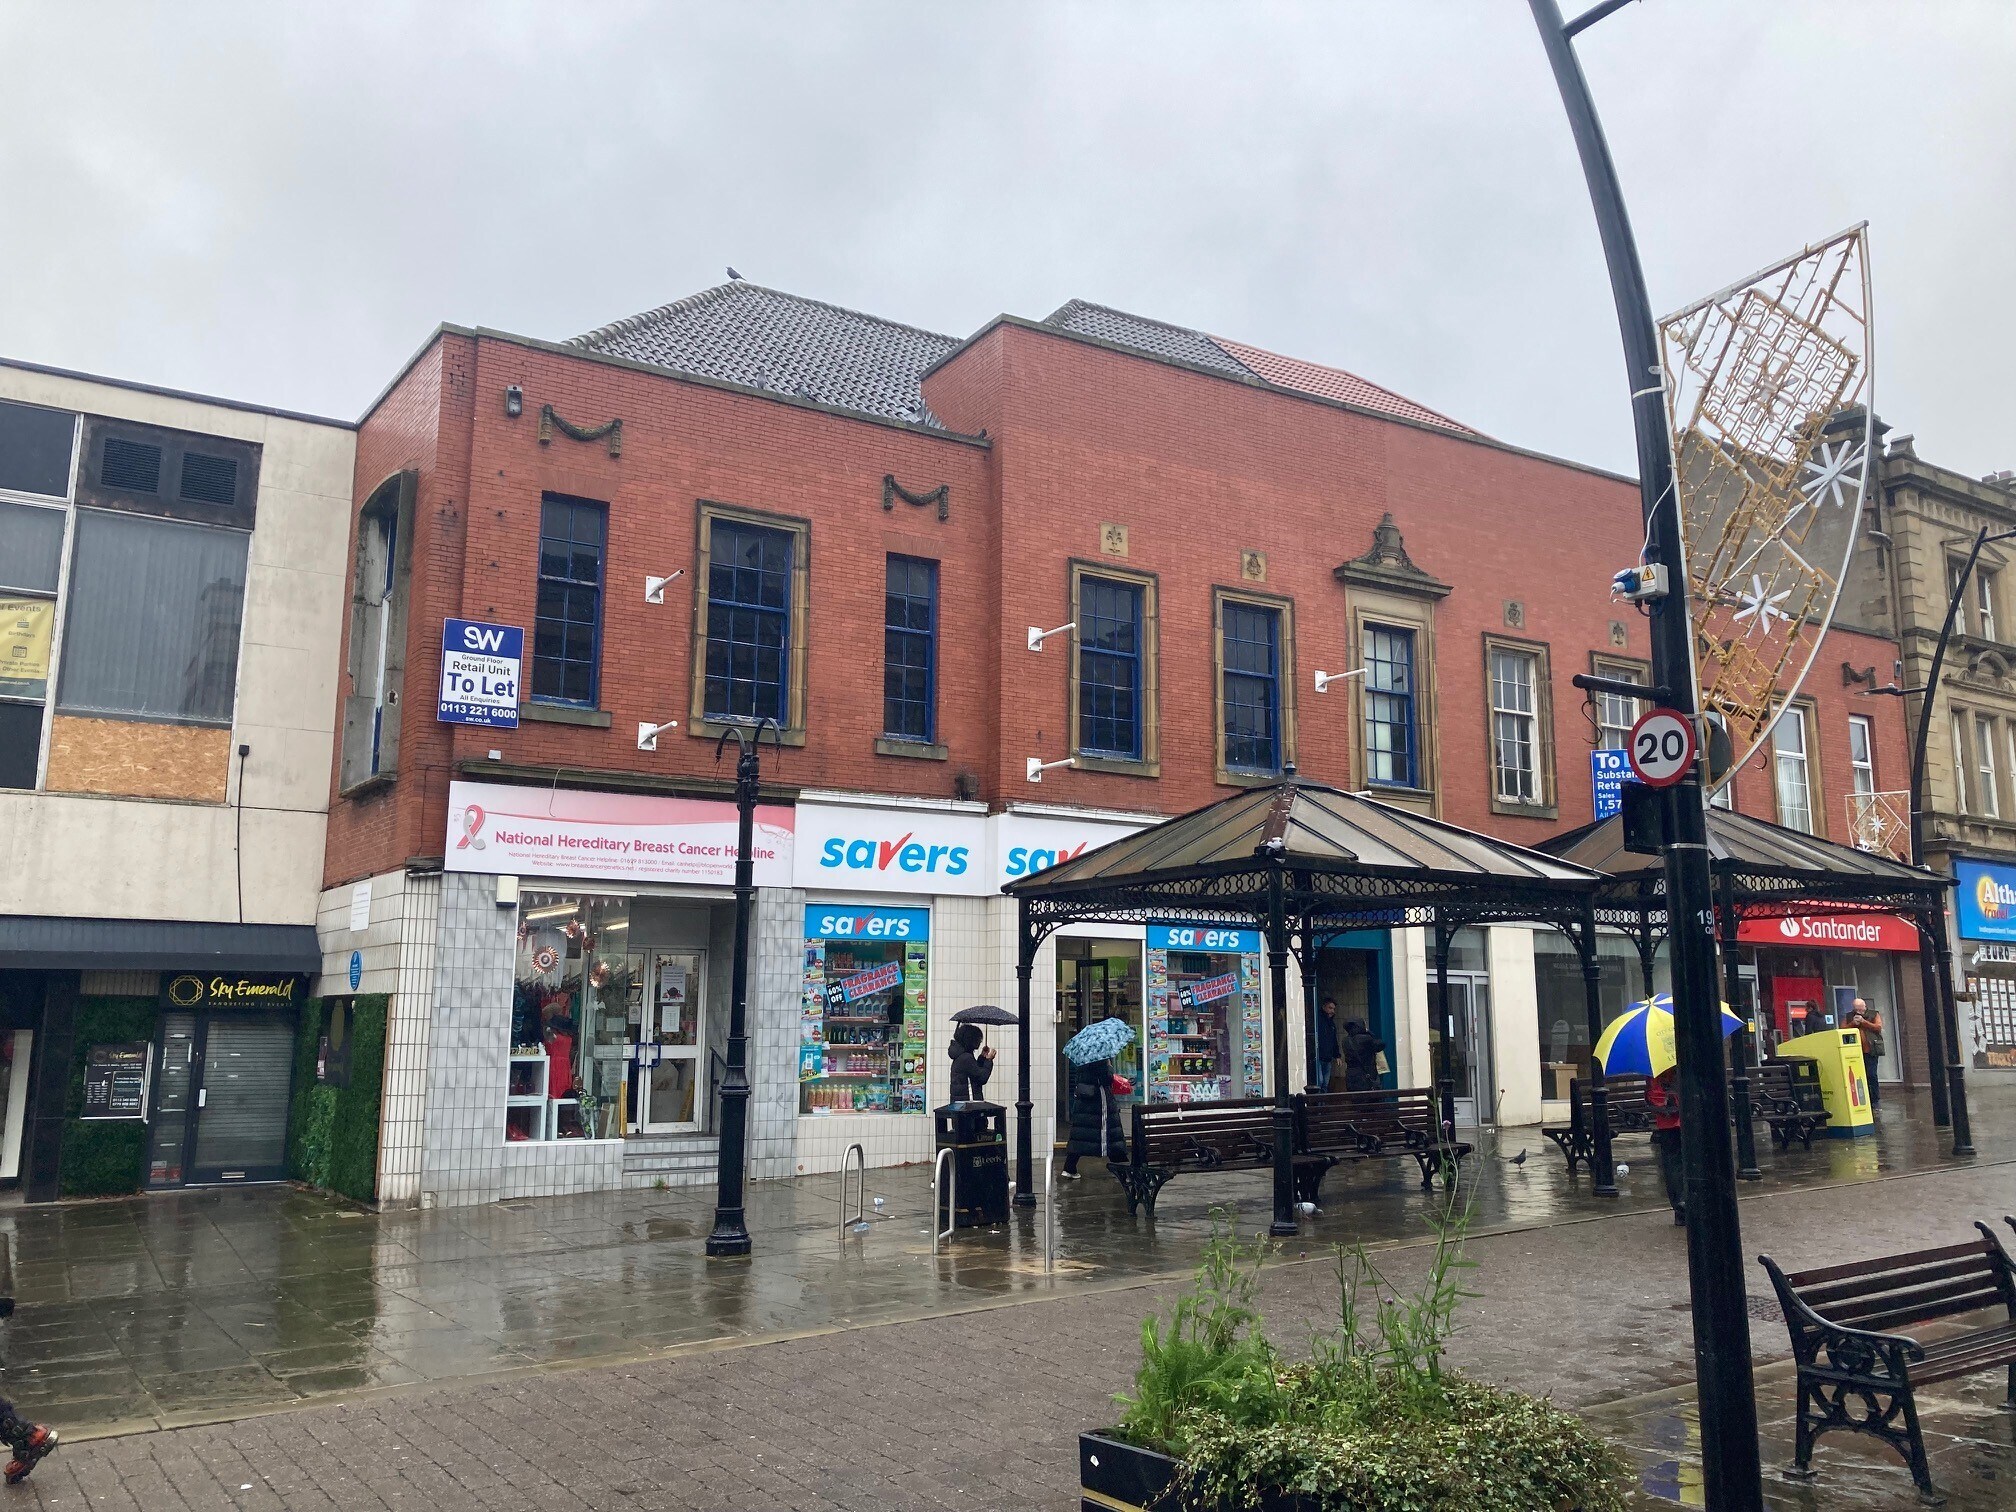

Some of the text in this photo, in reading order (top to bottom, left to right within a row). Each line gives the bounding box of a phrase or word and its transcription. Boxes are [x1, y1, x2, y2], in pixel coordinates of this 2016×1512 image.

[463, 626, 505, 652] SW
[452, 661, 511, 676] Retail Unit
[462, 653, 504, 665] Ground Floor
[447, 672, 515, 698] To Let
[470, 696, 500, 704] Enquiries
[441, 702, 517, 719] 0113 221 6000
[1637, 729, 1684, 765] 20
[1595, 752, 1620, 769] To
[1597, 781, 1622, 790] Reta
[1598, 799, 1622, 811] 1,57
[495, 831, 775, 859] National Hereditary Breast Cancer Heline
[820, 831, 969, 876] savers
[532, 852, 560, 860] Hereditary
[1006, 841, 1088, 876] sav
[820, 909, 911, 937] savers
[1802, 916, 1882, 942] Santander
[1168, 928, 1240, 948] savers
[842, 963, 898, 989] FRAGRANCE
[849, 974, 898, 998] CLEARANCE
[1191, 973, 1236, 994] FRAGRANCE
[210, 977, 294, 1000] Sky Emerald
[828, 985, 842, 996] 60%
[830, 994, 843, 1003] OFF
[1197, 982, 1236, 1002] CLEARANCE
[1182, 997, 1192, 1006] OFF
